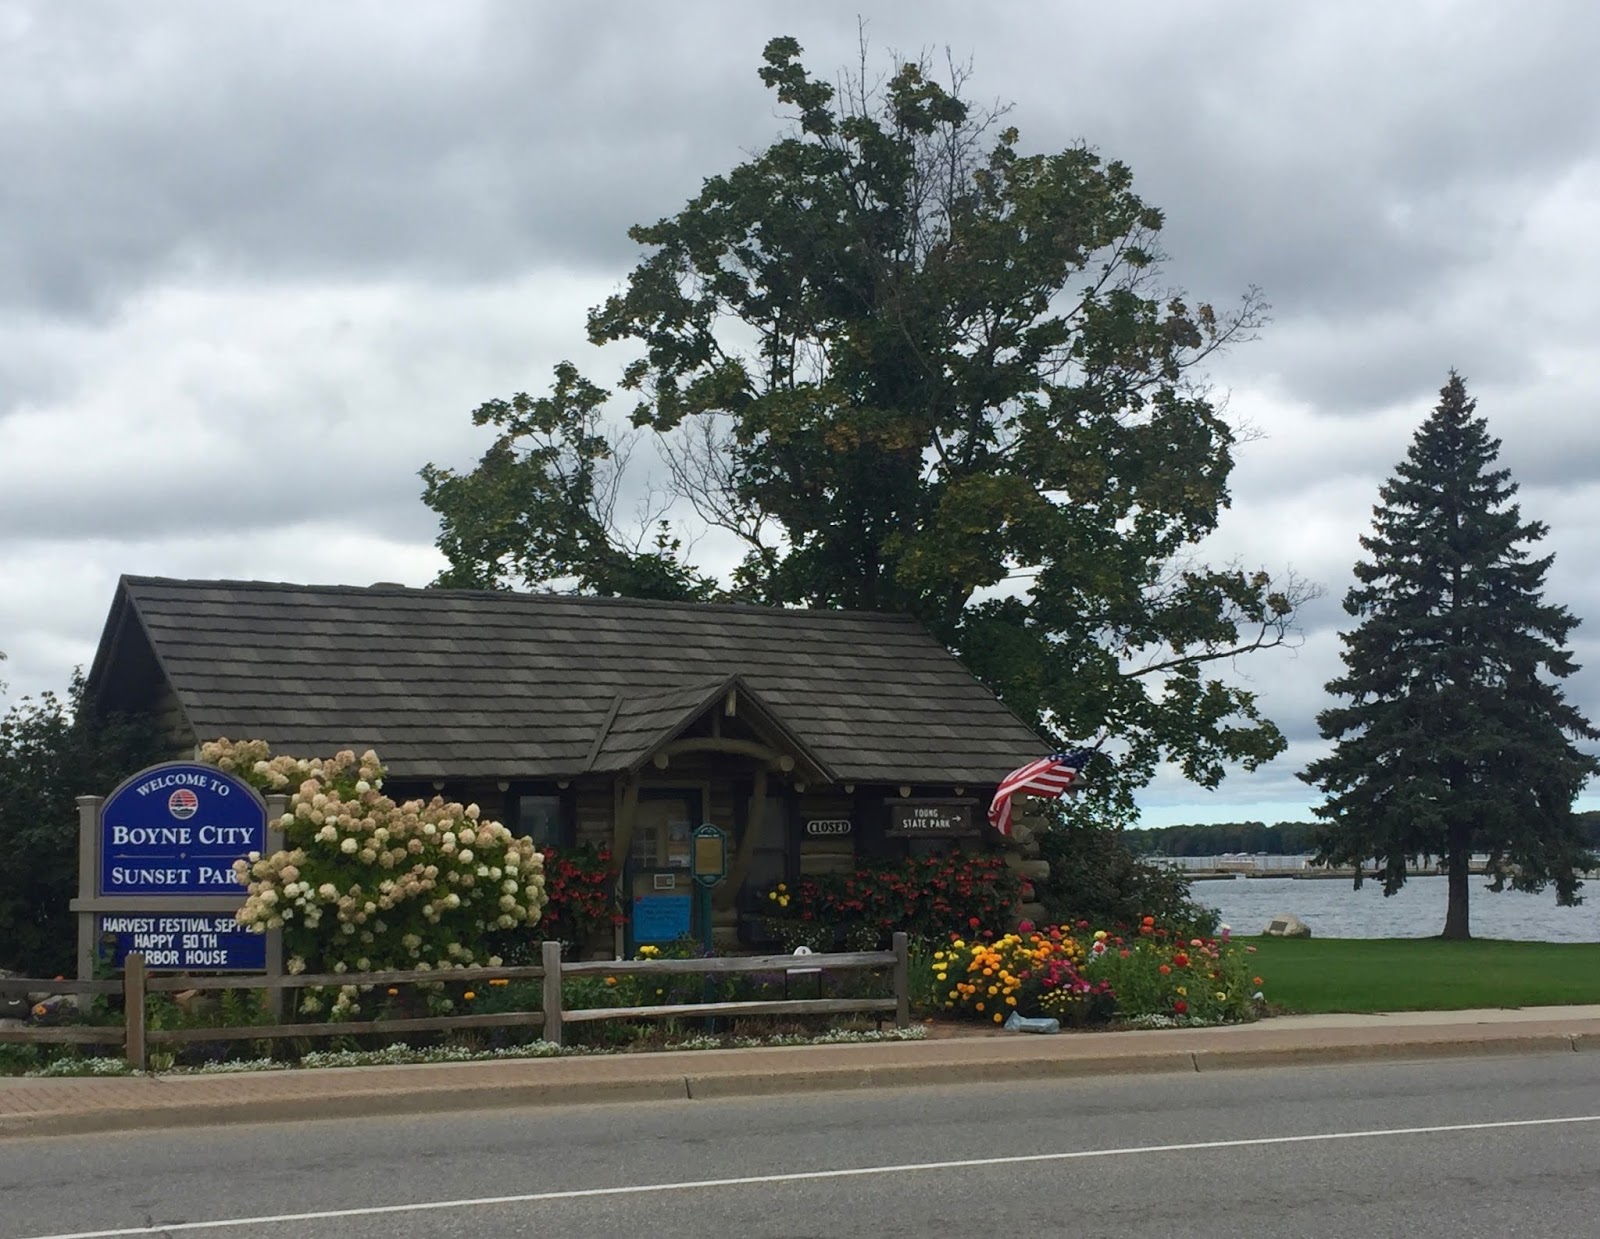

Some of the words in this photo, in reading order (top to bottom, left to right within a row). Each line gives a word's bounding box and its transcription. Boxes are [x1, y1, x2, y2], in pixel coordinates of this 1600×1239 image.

[136, 773, 207, 797] WELCOME
[210, 780, 230, 797] TO
[914, 808, 938, 818] YOUNG
[810, 821, 849, 833] CLOSED
[902, 819, 927, 829] STATE
[930, 819, 951, 828] PARK
[112, 825, 191, 845] BOYNE
[198, 825, 255, 845] CITY
[112, 867, 190, 885] SUNSET
[198, 867, 239, 885] PAR
[103, 917, 156, 932] HARVEST
[159, 918, 212, 932] FESTIVAL
[134, 934, 175, 948] HAPPY
[128, 950, 179, 965] RBOR
[185, 950, 228, 965] HOUSE
